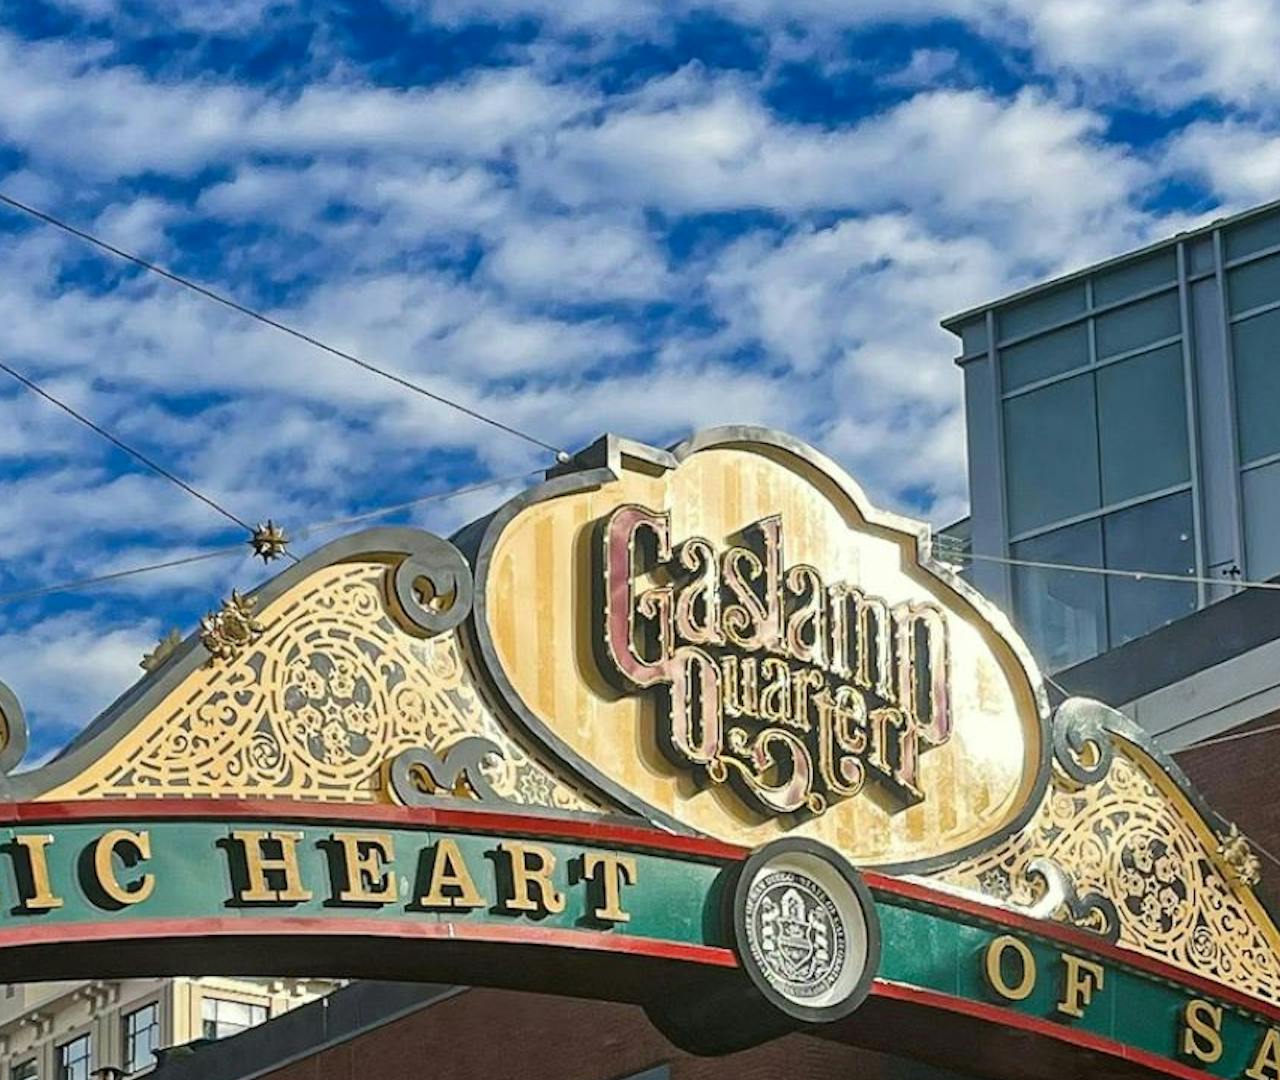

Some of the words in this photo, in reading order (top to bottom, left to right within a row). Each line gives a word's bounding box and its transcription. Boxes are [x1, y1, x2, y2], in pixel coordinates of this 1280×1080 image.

[602, 504, 952, 747] Gaslamp
[668, 647, 925, 816] Quarter
[230, 828, 637, 924] HEART
[984, 934, 1105, 1018] OF
